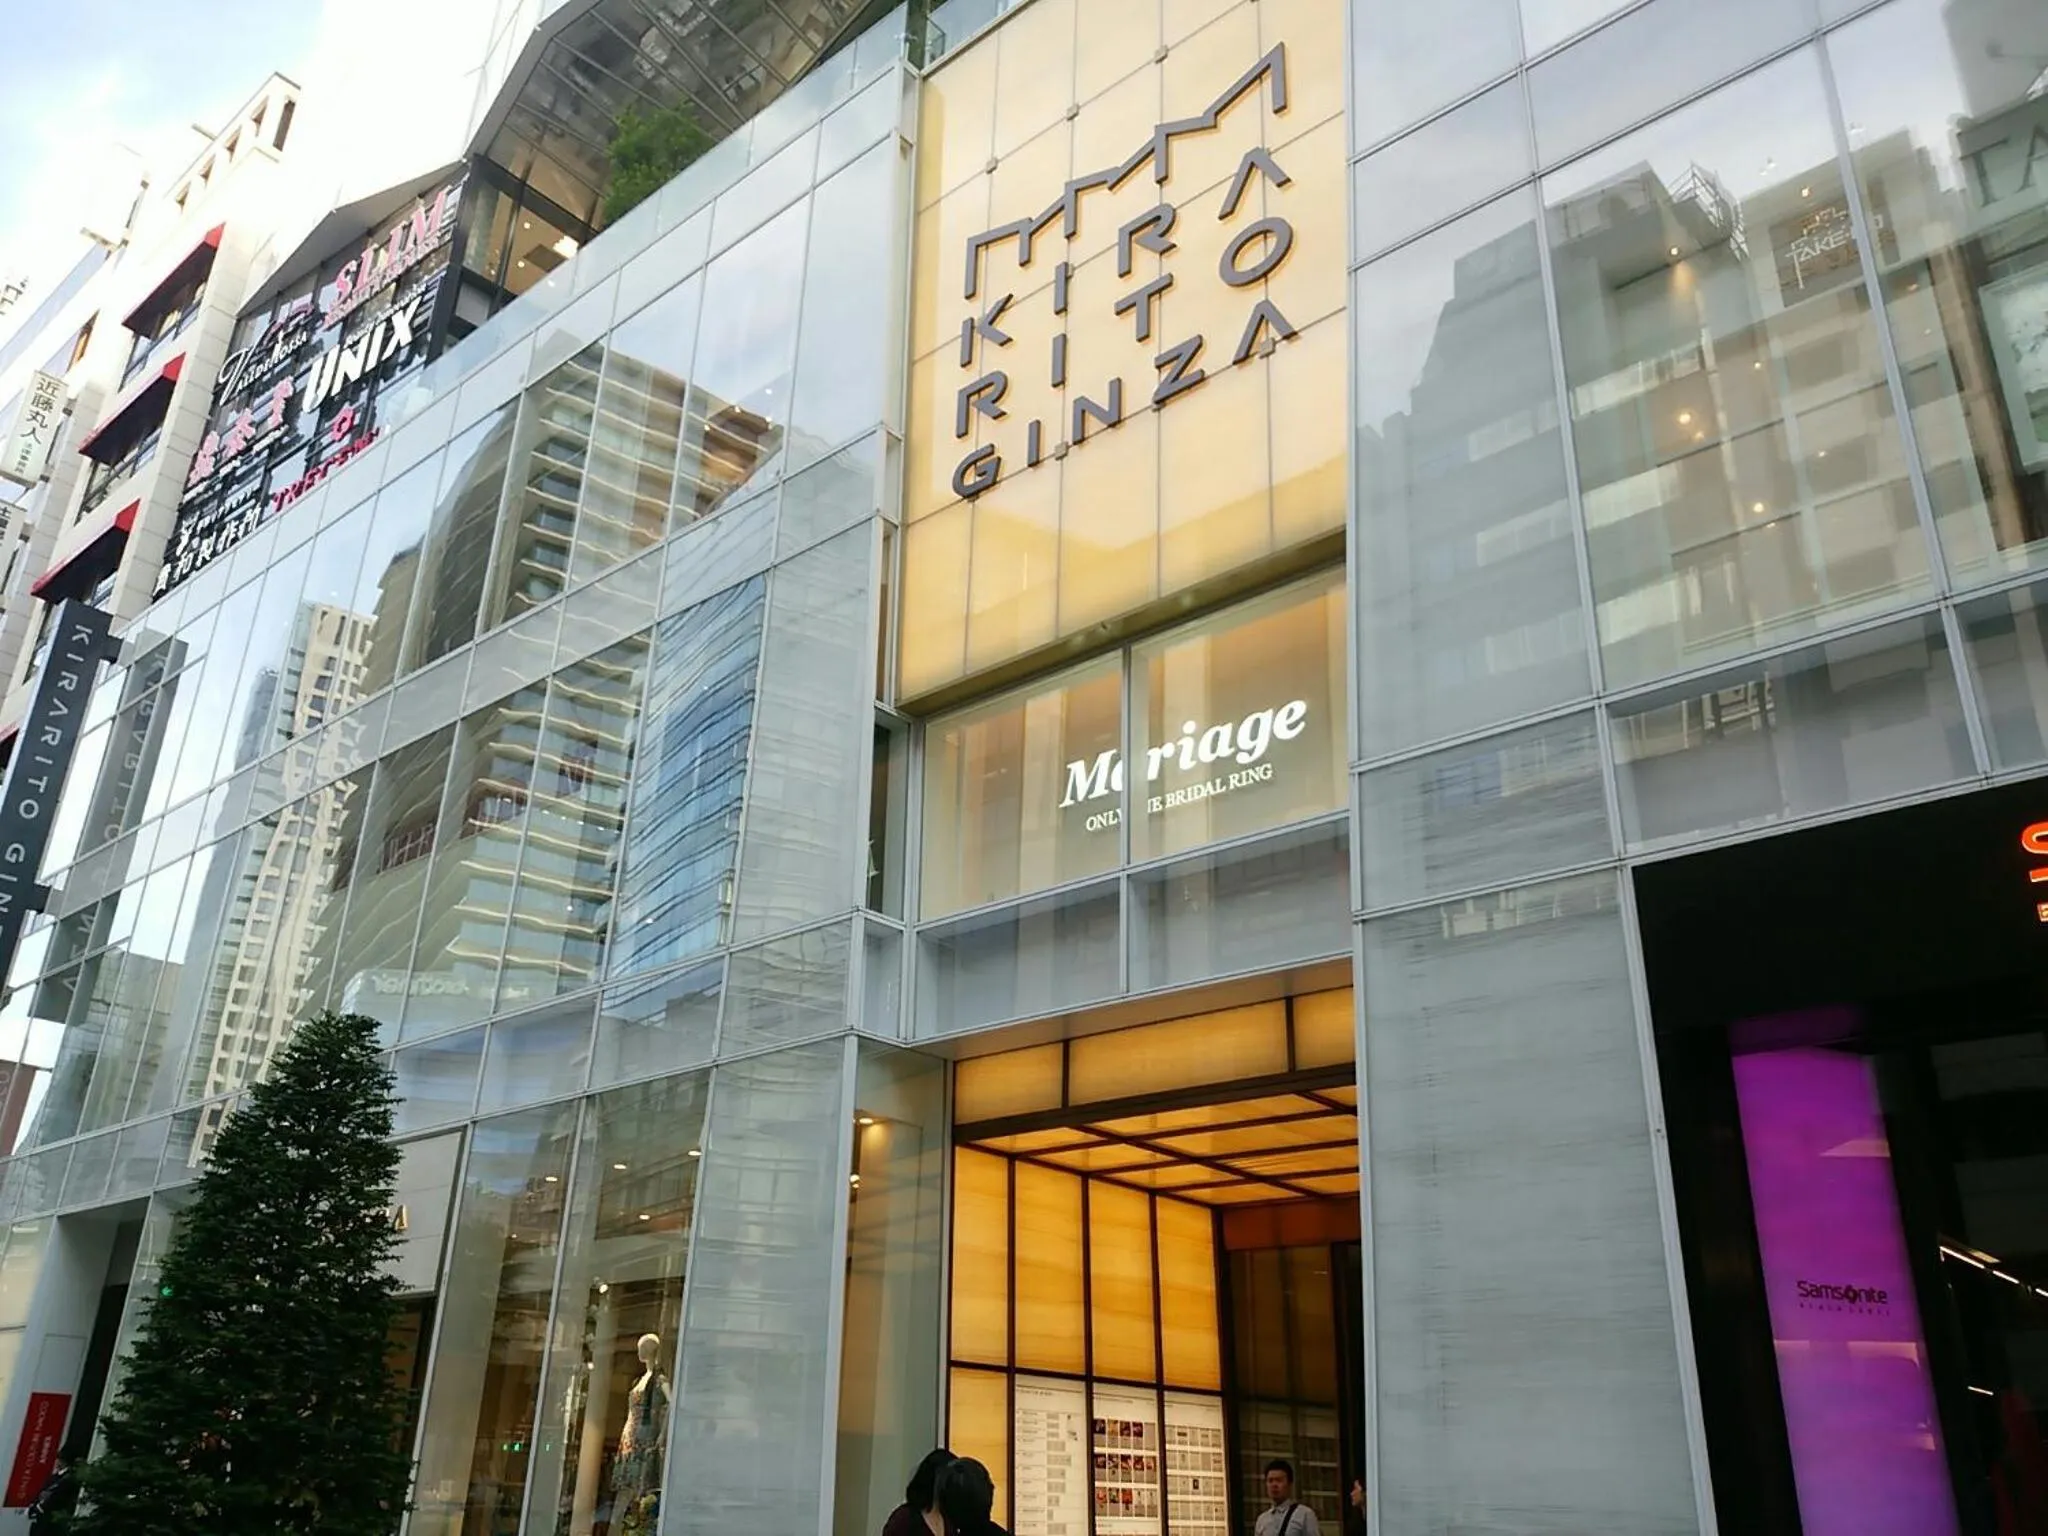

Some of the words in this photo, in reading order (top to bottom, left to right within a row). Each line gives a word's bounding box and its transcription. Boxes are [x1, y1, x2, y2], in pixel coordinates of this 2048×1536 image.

[327, 186, 452, 307] SLIM
[302, 295, 422, 413] UNIX
[952, 300, 1299, 499] GINZA
[19, 624, 93, 819] KIRARITO
[1165, 778, 1226, 808] BRIDAL
[1229, 763, 1274, 790] RING
[1797, 1280, 1889, 1304] Samsonite
